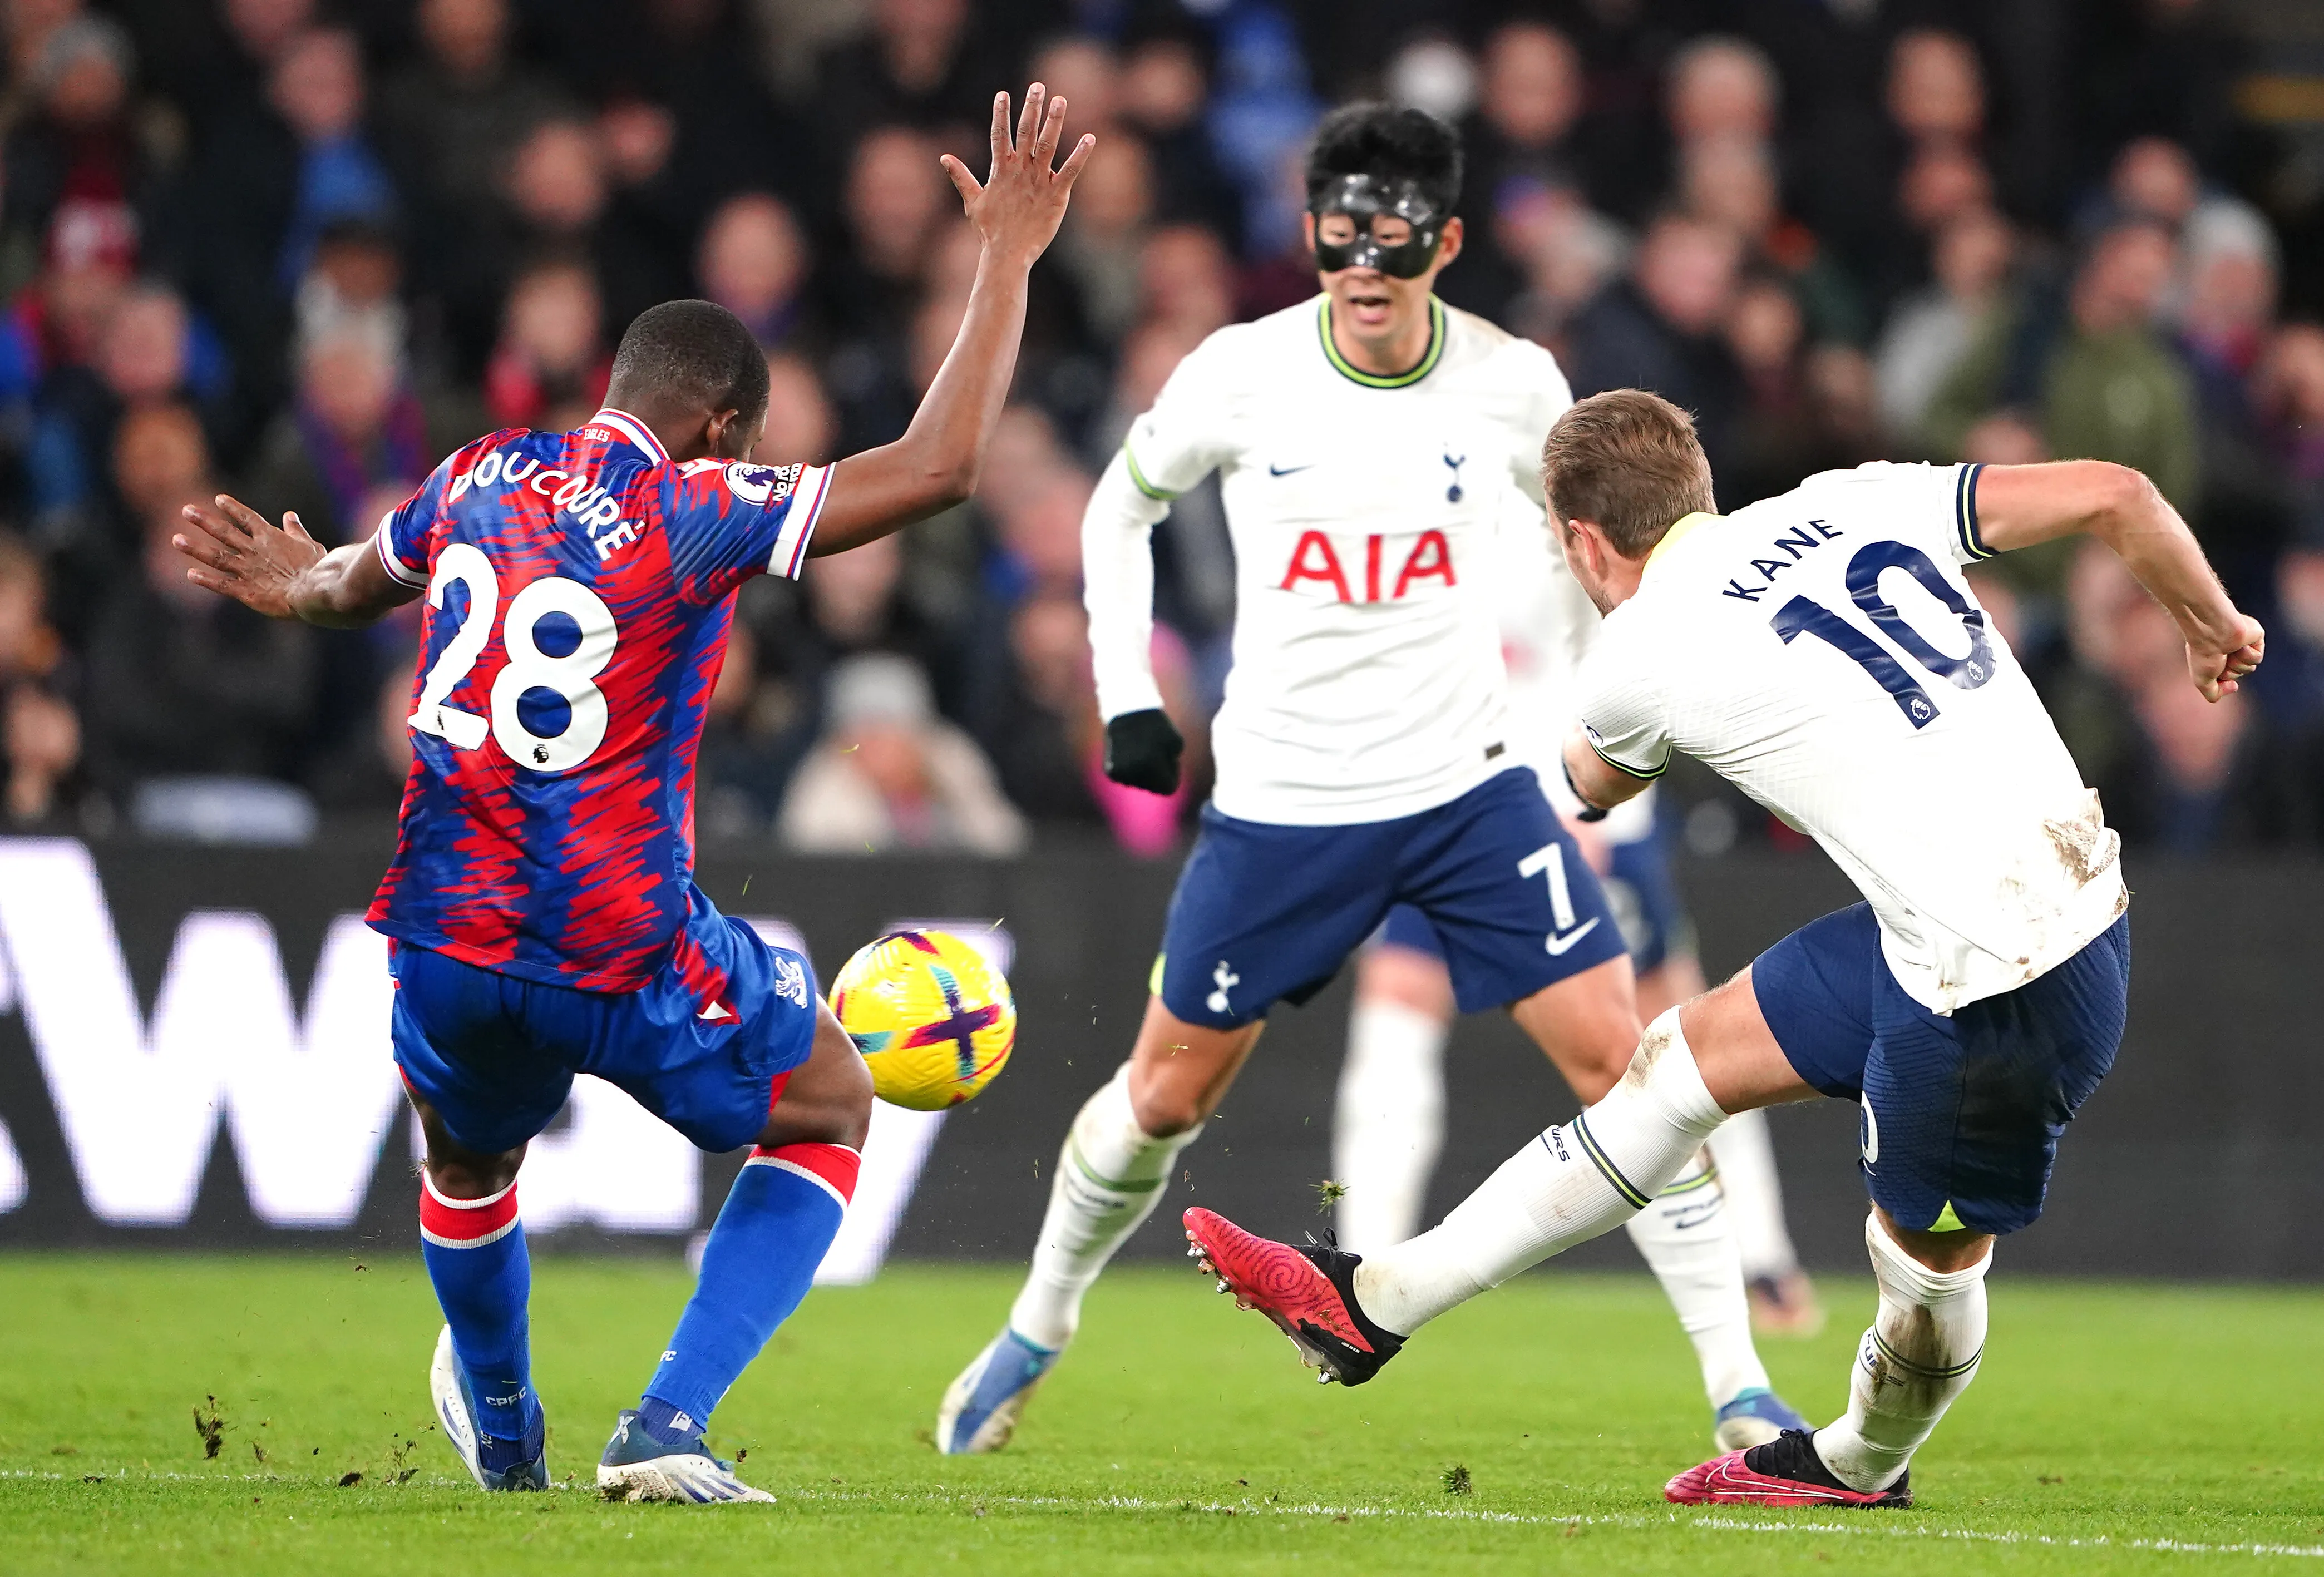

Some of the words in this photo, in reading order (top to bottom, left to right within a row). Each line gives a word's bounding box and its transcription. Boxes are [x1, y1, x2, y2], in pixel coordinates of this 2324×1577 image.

[1279, 530, 1458, 604] AIA
[1722, 519, 1843, 602] KANE
[407, 543, 619, 772] 28
[1769, 540, 1996, 730] 10
[1517, 842, 1576, 931] 7
[1552, 1126, 1571, 1161] URS
[485, 1386, 526, 1407] CPFC
